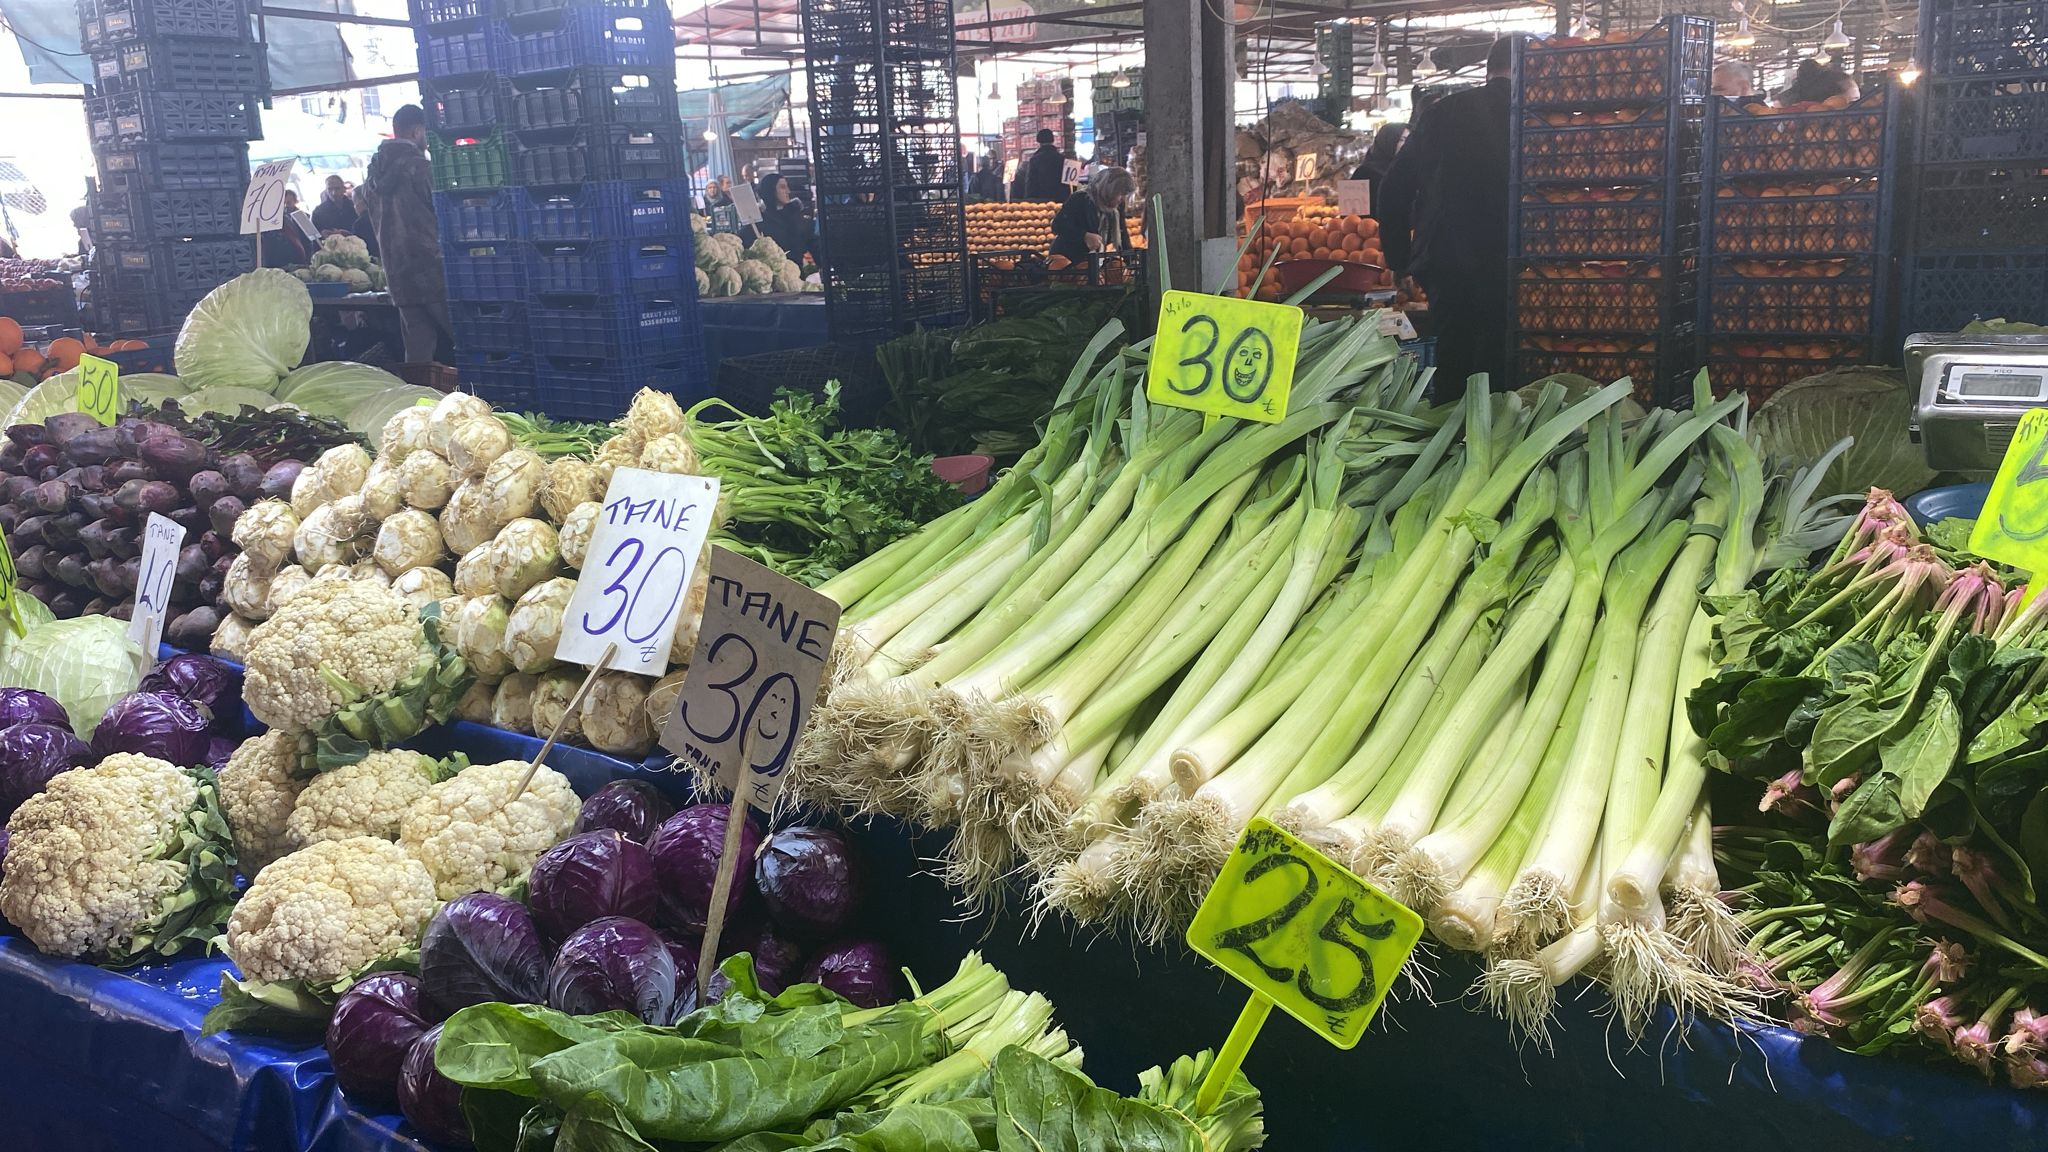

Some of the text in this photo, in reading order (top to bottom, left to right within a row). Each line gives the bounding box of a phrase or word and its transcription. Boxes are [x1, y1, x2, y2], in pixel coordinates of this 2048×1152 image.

[254, 161, 289, 178] TANE
[1064, 167, 1077, 182] 10
[1299, 158, 1315, 178] 10
[247, 179, 284, 222] 70
[1167, 314, 1274, 404] 30
[82, 363, 114, 415] 50
[150, 523, 175, 544] TANE
[605, 496, 697, 532] TANE
[583, 537, 686, 644] 30
[710, 575, 830, 662] TANE
[682, 632, 800, 778] 30
[685, 742, 721, 777] TANE
[1212, 853, 1396, 1014] 25
